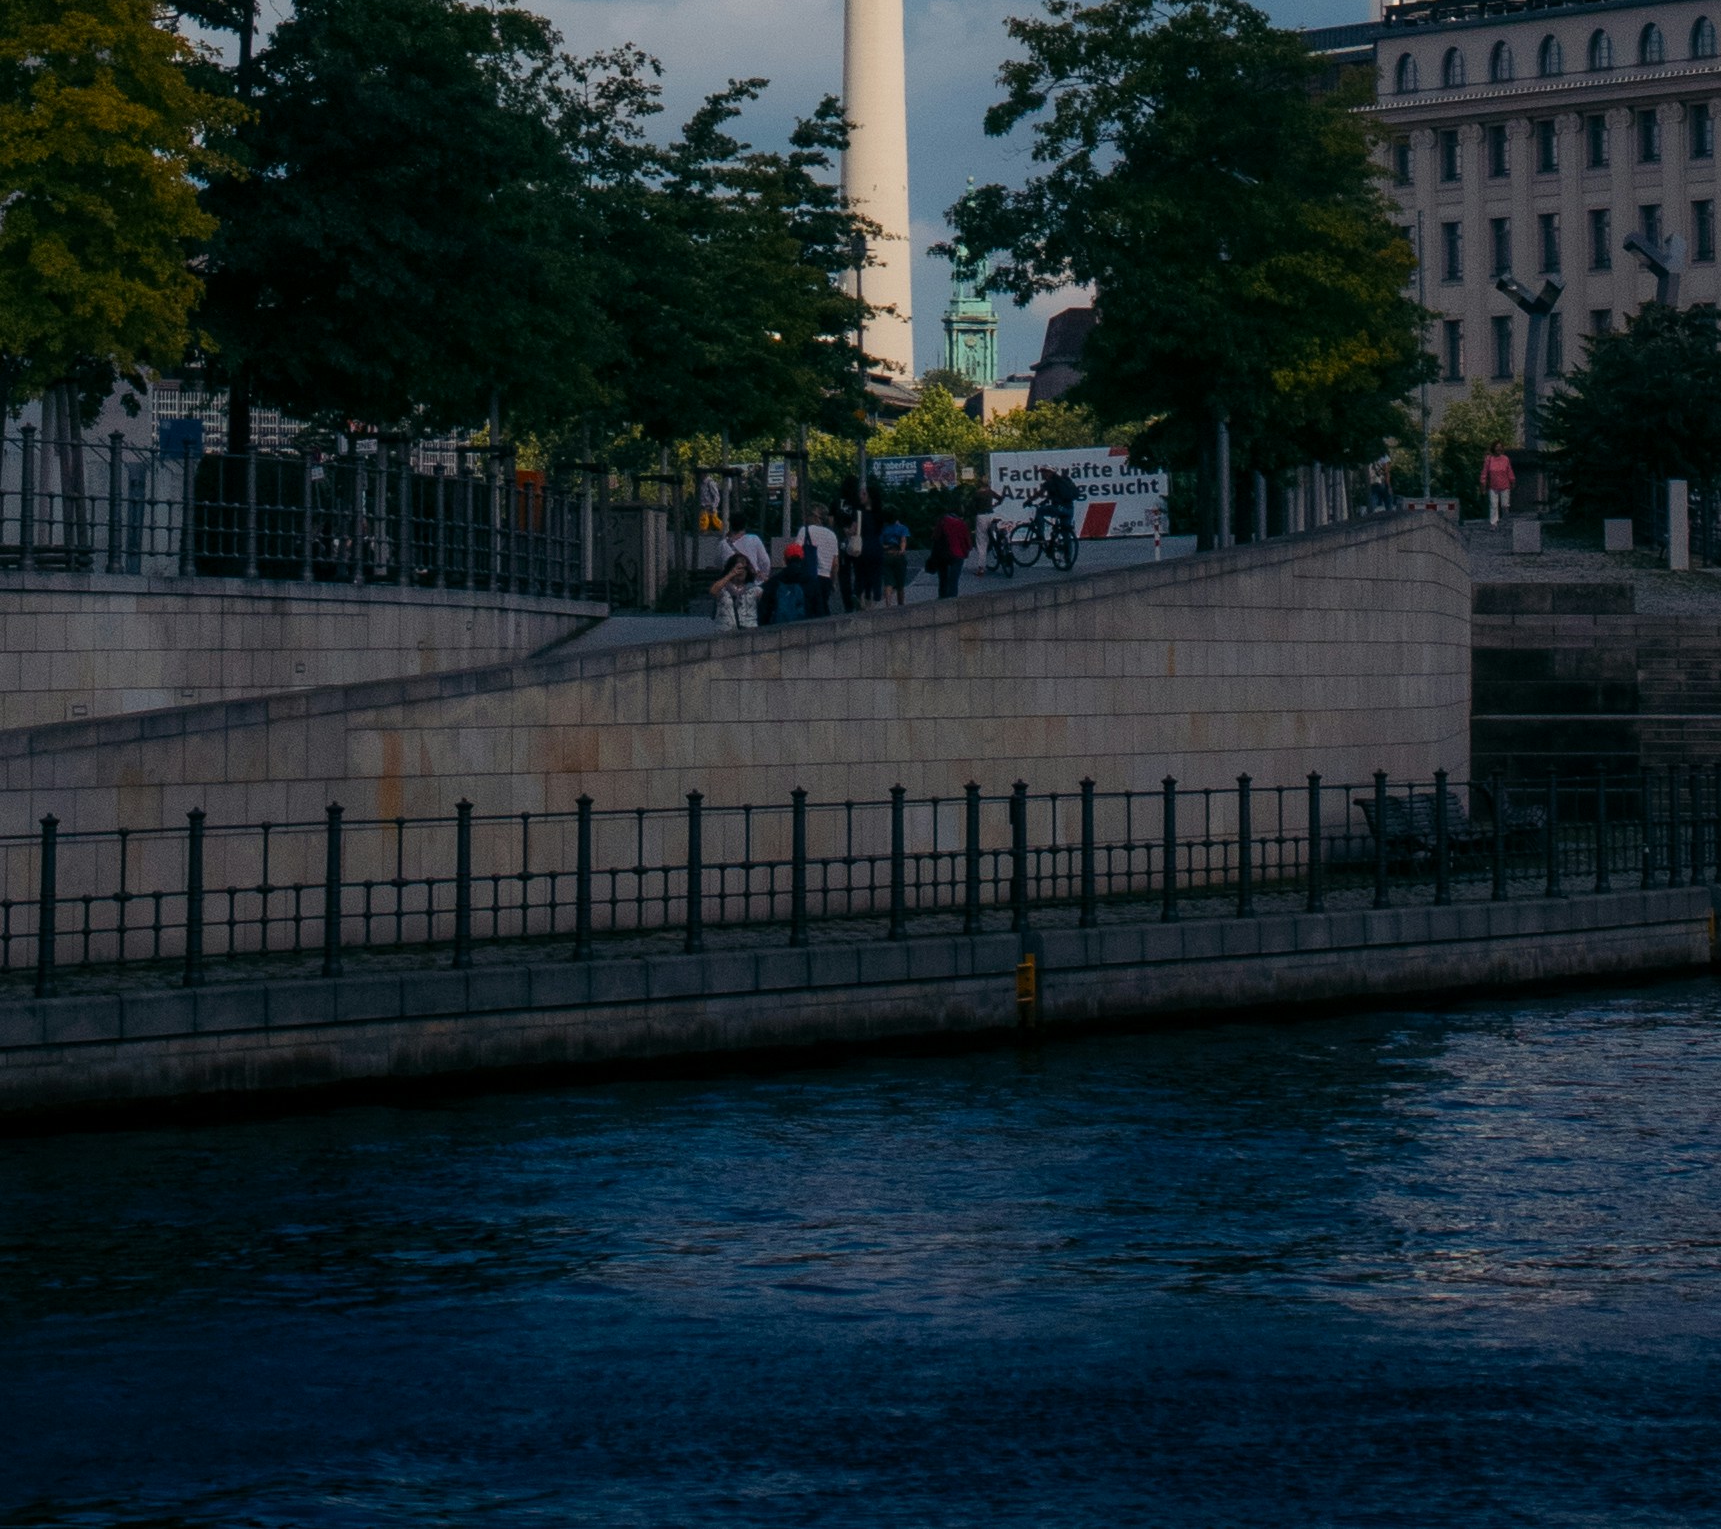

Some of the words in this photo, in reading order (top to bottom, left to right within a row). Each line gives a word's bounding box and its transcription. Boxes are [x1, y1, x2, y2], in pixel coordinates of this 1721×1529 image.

[999, 463, 1113, 482] Fachräfte
[1119, 462, 1158, 476] un
[1077, 479, 1159, 501] gesucht
